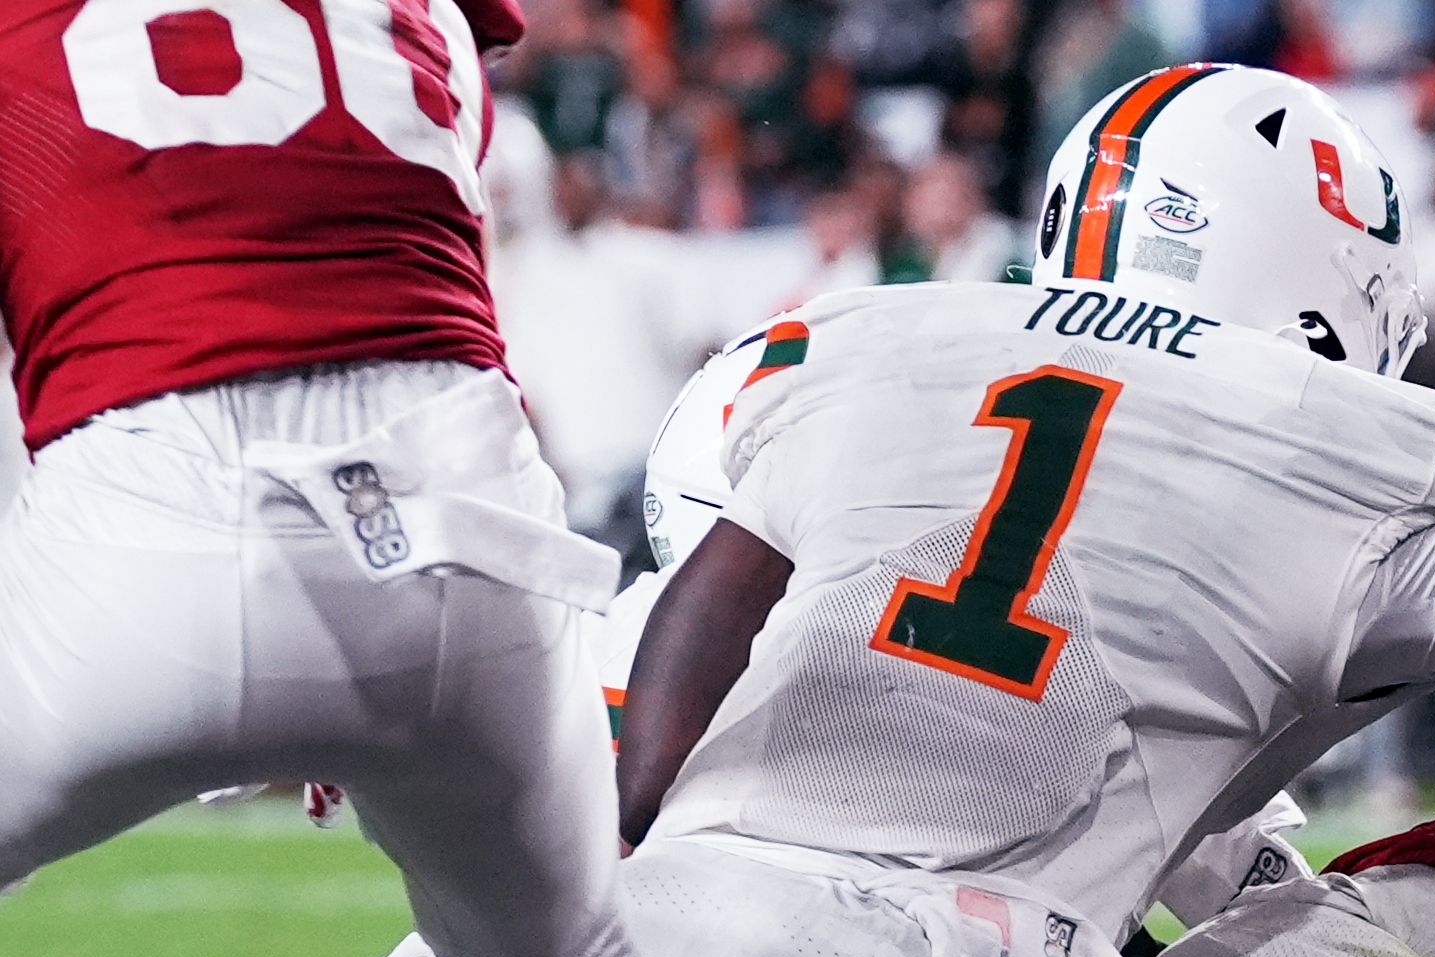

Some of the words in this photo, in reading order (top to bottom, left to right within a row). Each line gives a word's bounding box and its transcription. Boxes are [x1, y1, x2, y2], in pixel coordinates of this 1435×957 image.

[1154, 204, 1197, 223] ACC
[1024, 287, 1221, 359] TOURE
[868, 364, 1124, 701] 1
